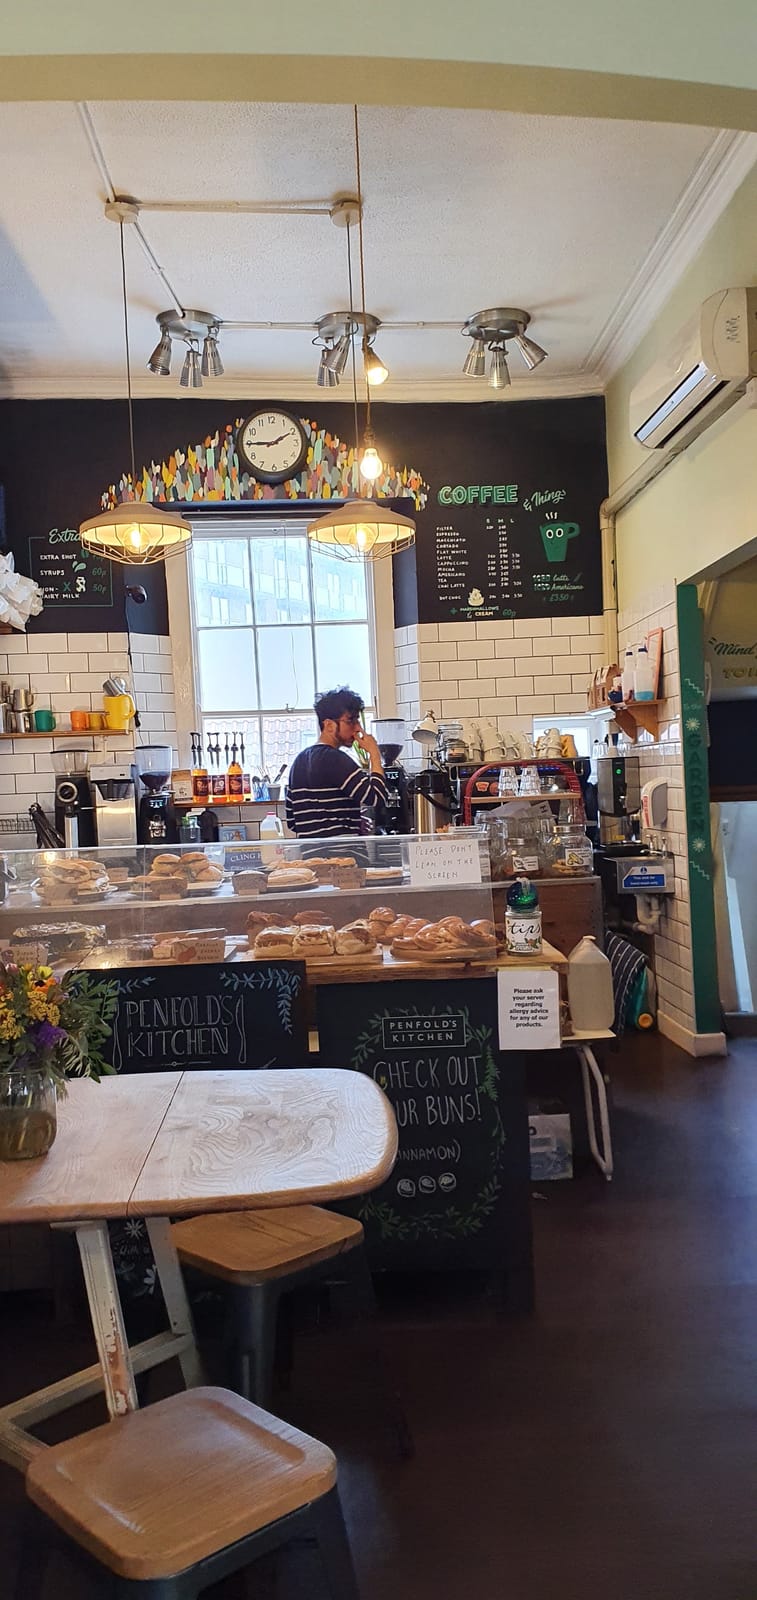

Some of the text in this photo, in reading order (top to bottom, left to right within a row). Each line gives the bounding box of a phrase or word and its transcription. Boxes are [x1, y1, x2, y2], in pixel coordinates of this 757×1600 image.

[258, 419, 264, 427] 11
[267, 415, 276, 425] 12
[249, 427, 257, 436] 10
[289, 427, 296, 436] 2
[293, 439, 298, 447] 3
[250, 452, 257, 460] 8
[271, 464, 277, 472] 6
[283, 460, 289, 468] 5
[437, 484, 518, 506] COFFEE
[531, 488, 566, 508] Things
[460, 605, 499, 613] MARSHMALLOWS
[688, 734, 706, 833] GARDEN
[415, 845, 444, 856] PLEASE
[230, 852, 256, 862] CLING
[415, 860, 436, 869] LEAN
[457, 857, 473, 865] THE
[425, 871, 458, 880] SCREEN
[508, 922, 541, 937] tips
[124, 995, 234, 1028] PENFOLD'S
[389, 1020, 457, 1031] PENFOLD'S
[127, 1026, 230, 1058] KITCHEN
[391, 1033, 453, 1043] KITCHEN
[373, 1055, 482, 1091] CHECK OUT
[396, 1087, 482, 1127] UR BUNS!
